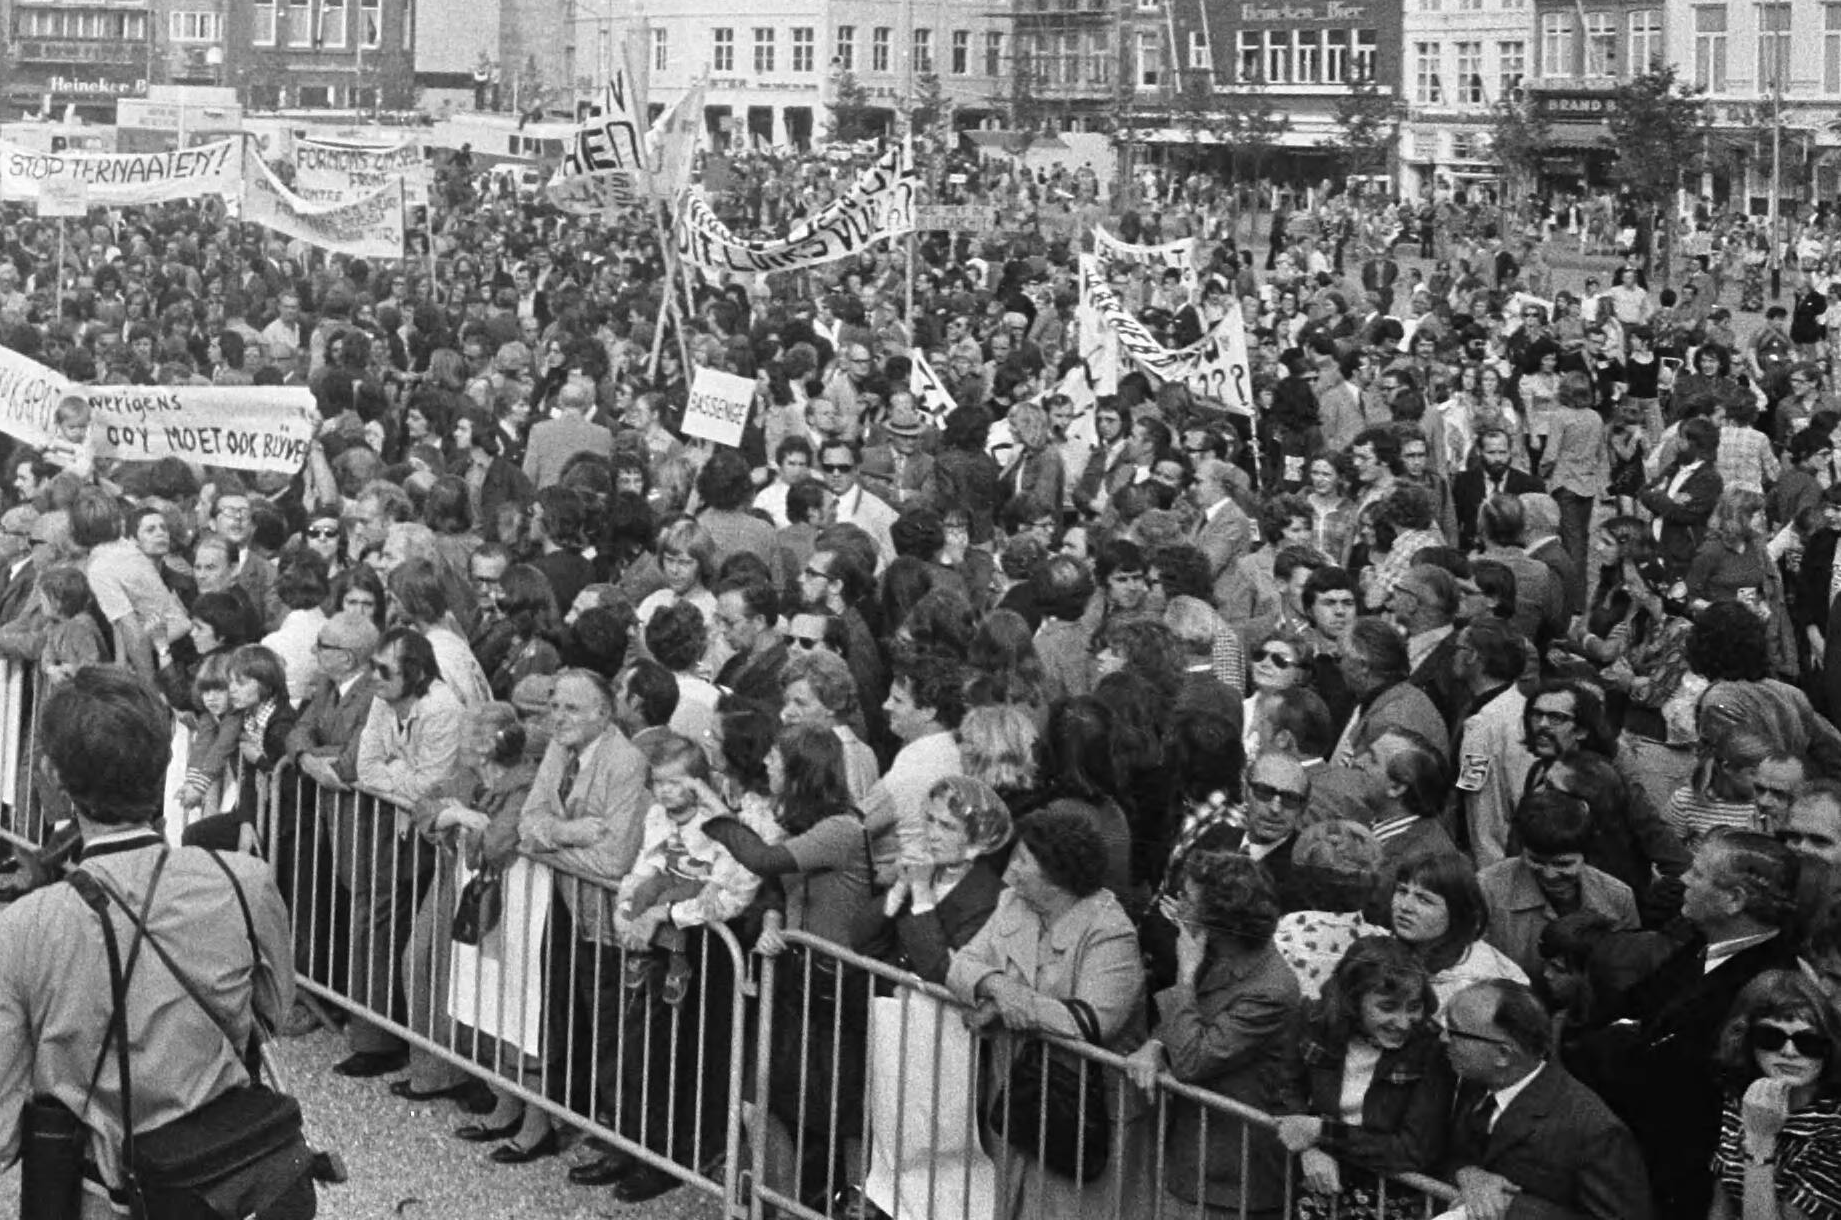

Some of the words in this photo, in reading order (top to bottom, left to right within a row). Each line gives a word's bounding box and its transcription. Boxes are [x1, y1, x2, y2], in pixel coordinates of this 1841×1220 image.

[1548, 98, 1601, 112] BRAND
[9, 153, 64, 180] STOP
[165, 427, 223, 455] MOET
[227, 431, 257, 459] OOK
